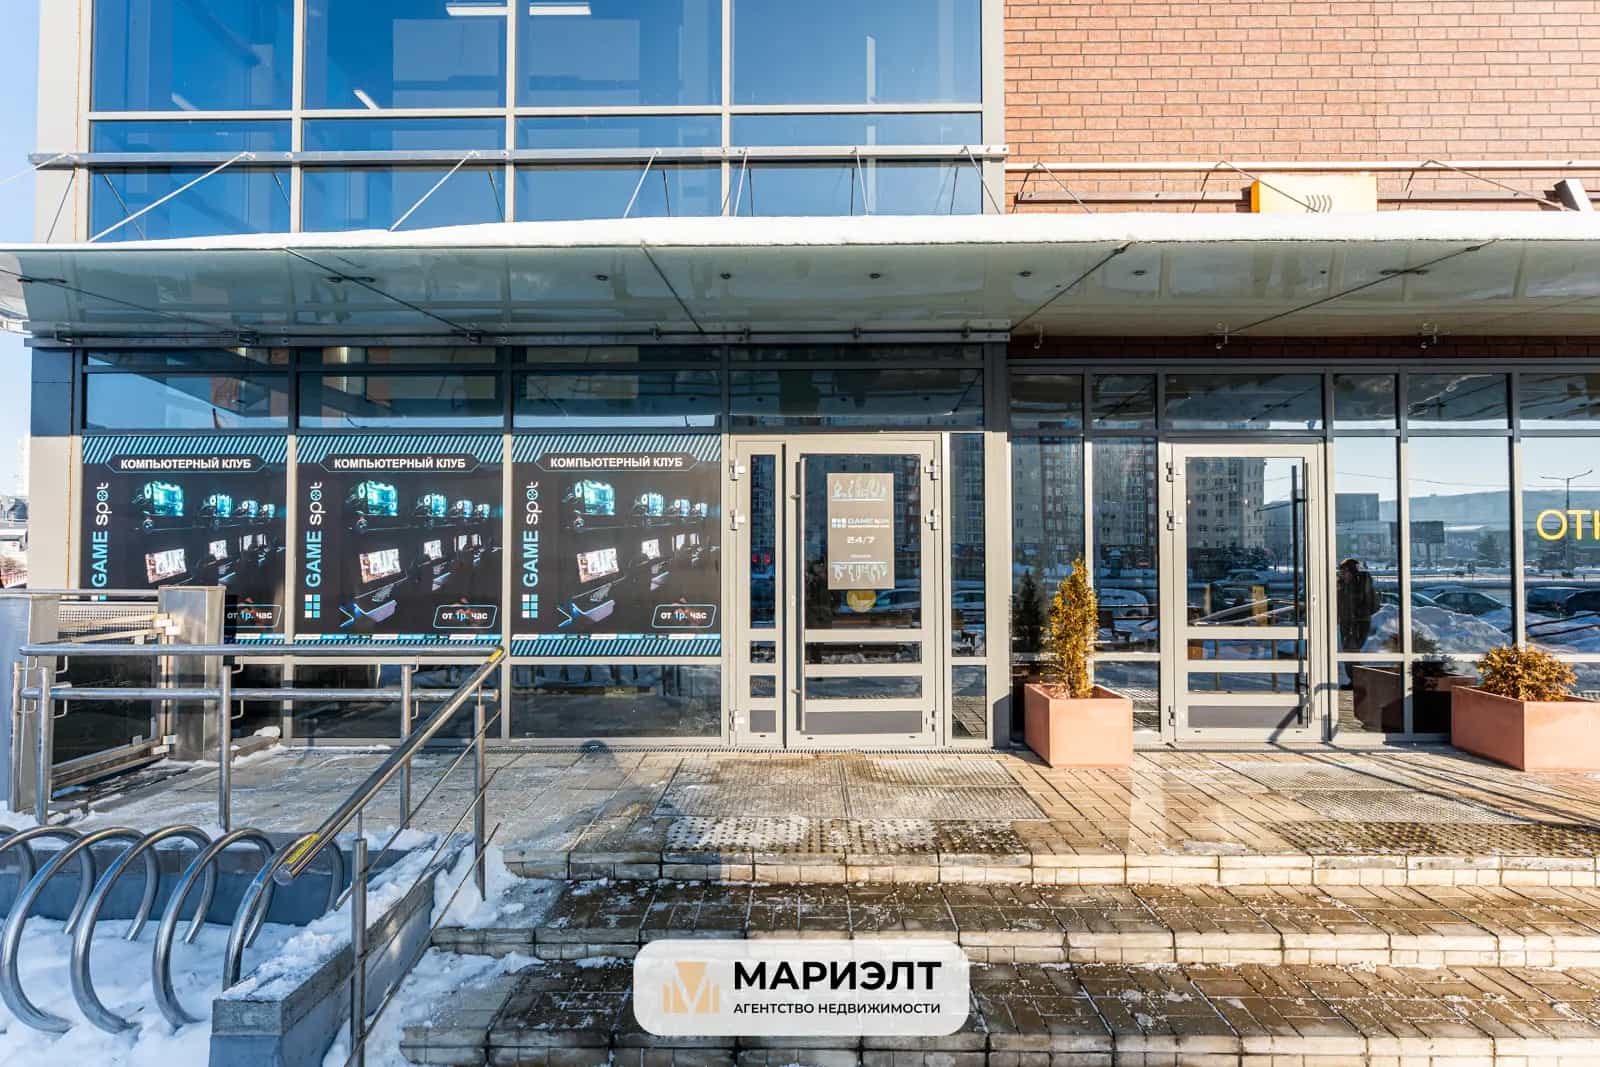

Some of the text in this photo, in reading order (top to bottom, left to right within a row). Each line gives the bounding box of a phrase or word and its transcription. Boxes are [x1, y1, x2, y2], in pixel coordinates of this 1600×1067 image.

[120, 457, 251, 470] КОМПЬЮТЕРНЫЙ КЛУБ
[334, 457, 466, 469] КОМПЬЮТЕРНЫЙ КЛУБ
[550, 456, 683, 468] КОМПЬЮТЕРНЫЙ КЛУБ
[92, 530, 109, 588] GAME
[305, 530, 322, 588] GAME
[522, 530, 539, 588] GAME
[227, 611, 237, 619] от
[256, 611, 273, 619] час
[442, 612, 453, 620] от
[472, 612, 488, 620] час
[660, 612, 672, 620] от
[690, 611, 707, 620] час
